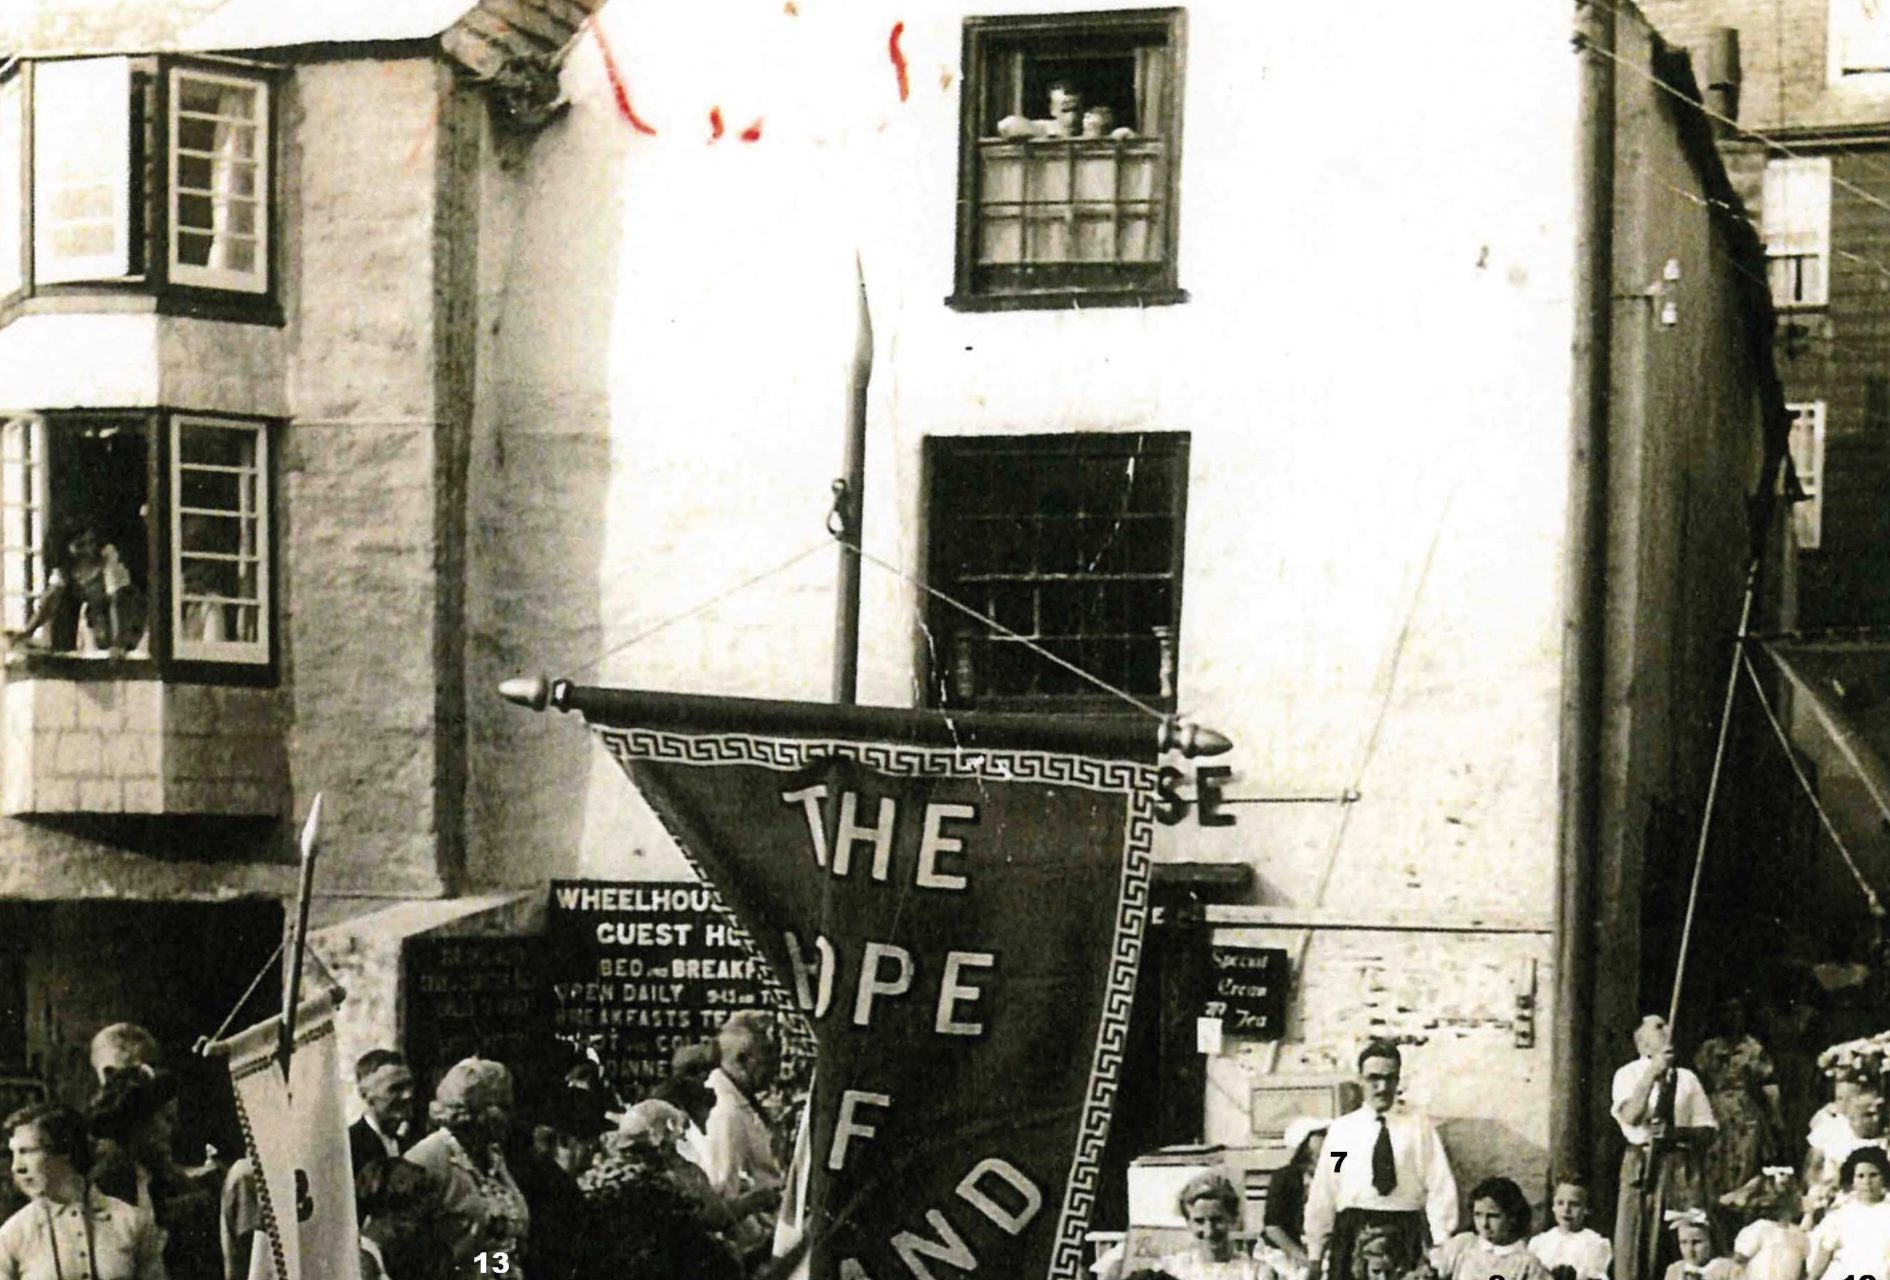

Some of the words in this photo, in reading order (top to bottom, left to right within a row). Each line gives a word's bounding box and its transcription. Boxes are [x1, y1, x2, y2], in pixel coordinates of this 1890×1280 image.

[782, 784, 975, 889] THE
[596, 922, 693, 946] GUEST
[623, 983, 683, 1002] DAILY
[1235, 1009, 1267, 1028] Tea
